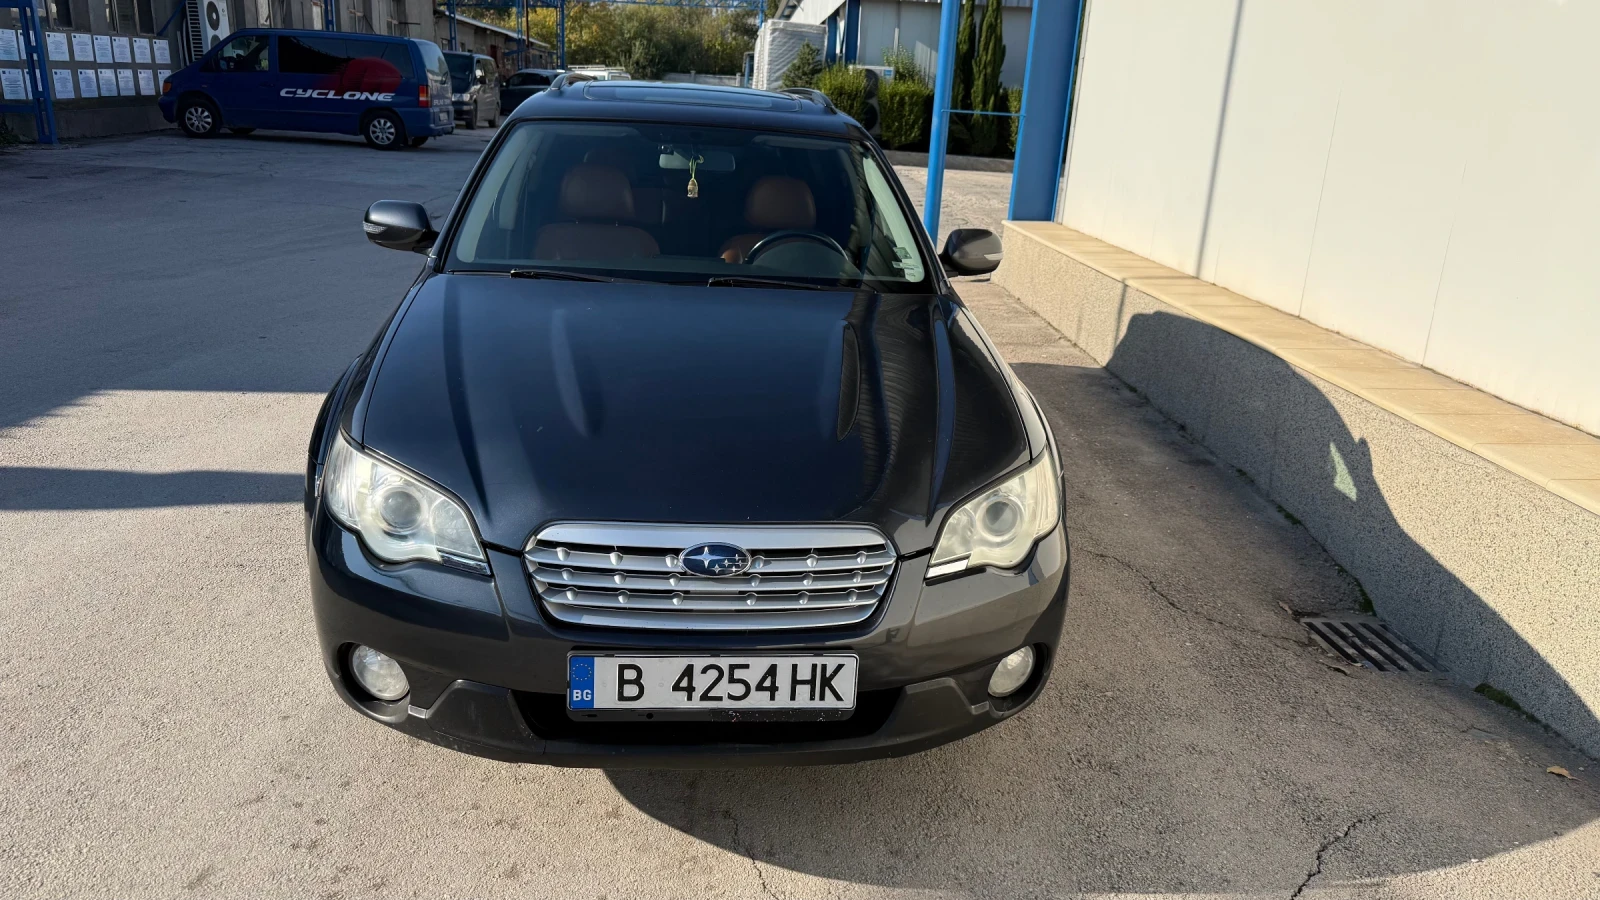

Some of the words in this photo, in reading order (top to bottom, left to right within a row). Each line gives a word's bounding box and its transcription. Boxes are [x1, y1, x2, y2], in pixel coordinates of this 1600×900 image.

[280, 88, 395, 101] CYCLONE
[671, 663, 779, 701] 4254
[789, 663, 846, 702] HK
[573, 690, 592, 701] BG
